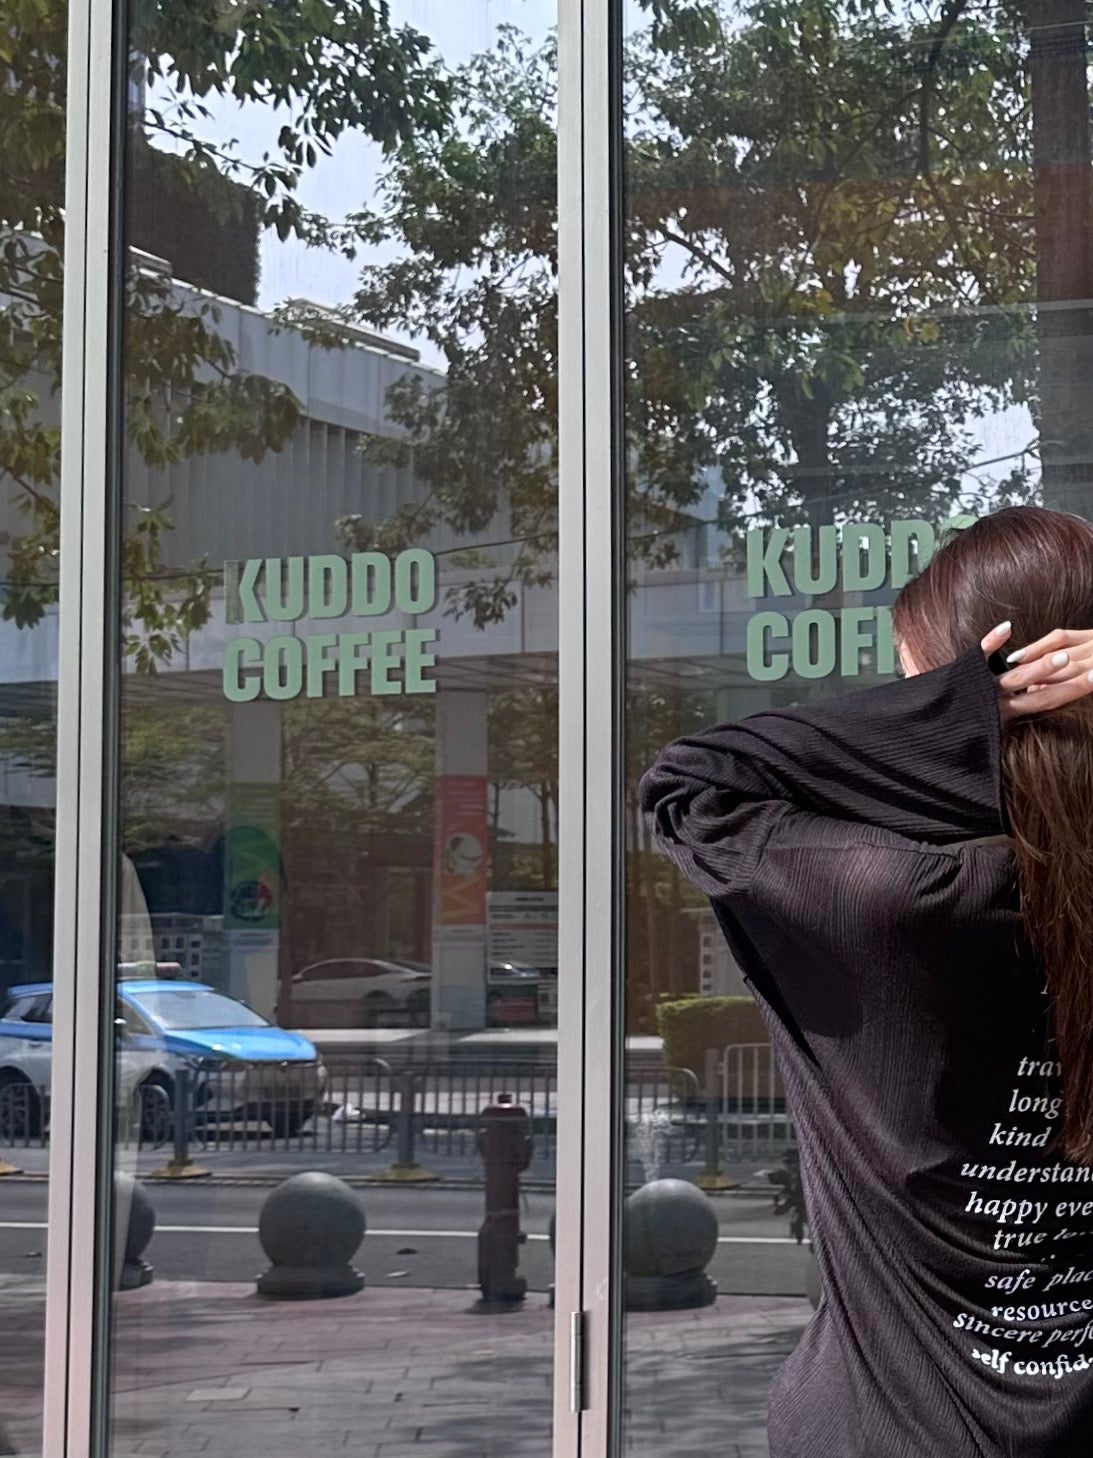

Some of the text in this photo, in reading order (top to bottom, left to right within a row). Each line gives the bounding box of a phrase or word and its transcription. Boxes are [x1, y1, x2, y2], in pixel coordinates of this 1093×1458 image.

[746, 514, 978, 598] KUDD
[224, 548, 435, 624] KUDDO
[223, 628, 437, 702] COFFEE
[1008, 1088, 1063, 1120] long
[988, 1122, 1052, 1148] kind
[964, 1191, 1048, 1225] happy
[993, 1228, 1048, 1250] true
[984, 1268, 1036, 1294] safe
[952, 1308, 1044, 1344] sincere
[1013, 1354, 1093, 1380] confid
